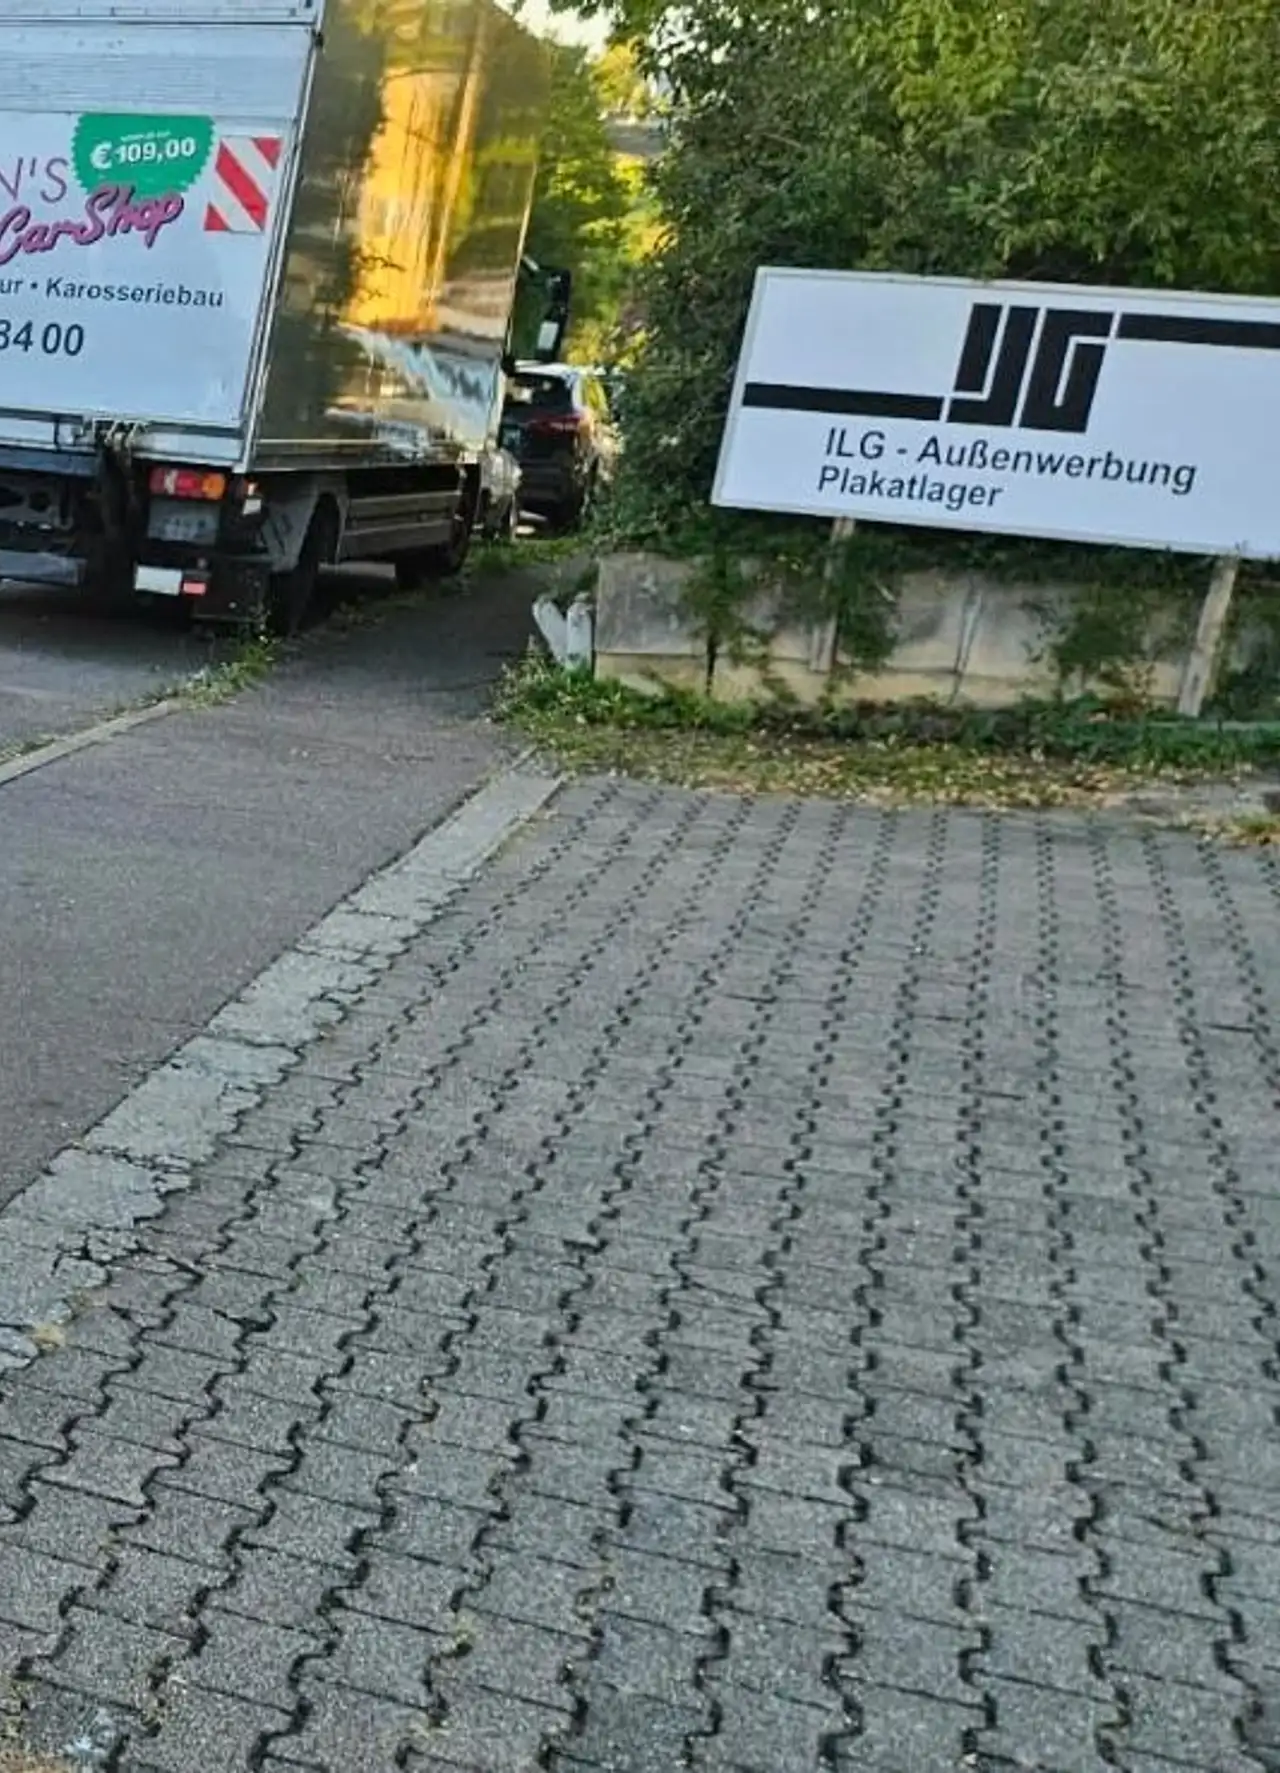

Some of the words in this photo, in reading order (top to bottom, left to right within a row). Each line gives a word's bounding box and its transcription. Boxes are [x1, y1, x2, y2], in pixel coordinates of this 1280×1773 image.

[46, 276, 224, 308] Karosseriebau
[41, 322, 85, 356] 00
[826, 427, 885, 460] ILG
[917, 434, 1197, 495] Außenwerbung
[817, 463, 1004, 511] Plakatlager
